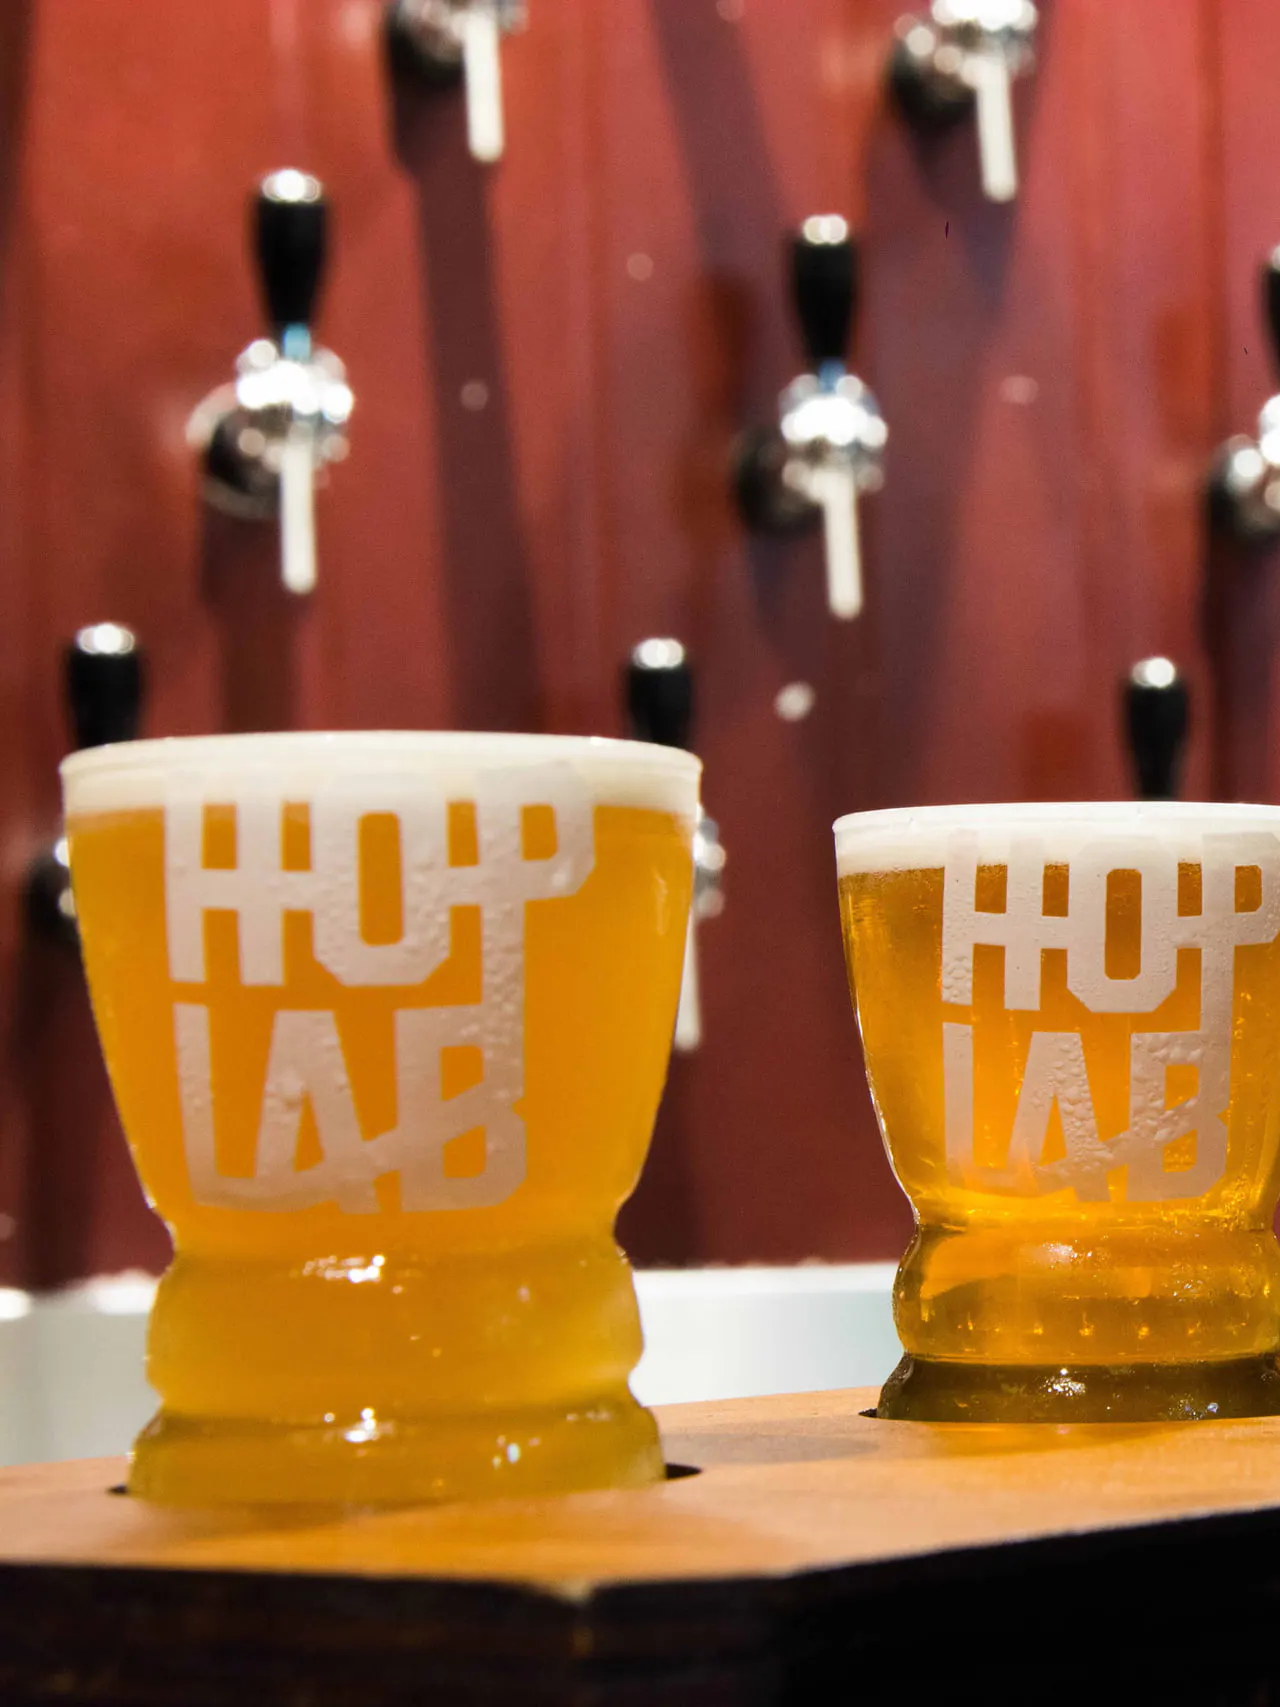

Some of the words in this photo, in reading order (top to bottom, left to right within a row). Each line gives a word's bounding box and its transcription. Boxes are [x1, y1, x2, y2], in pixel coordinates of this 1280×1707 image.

[163, 762, 596, 987] HOP
[171, 1000, 527, 1214] LAB
[942, 1022, 1231, 1202] LAB
